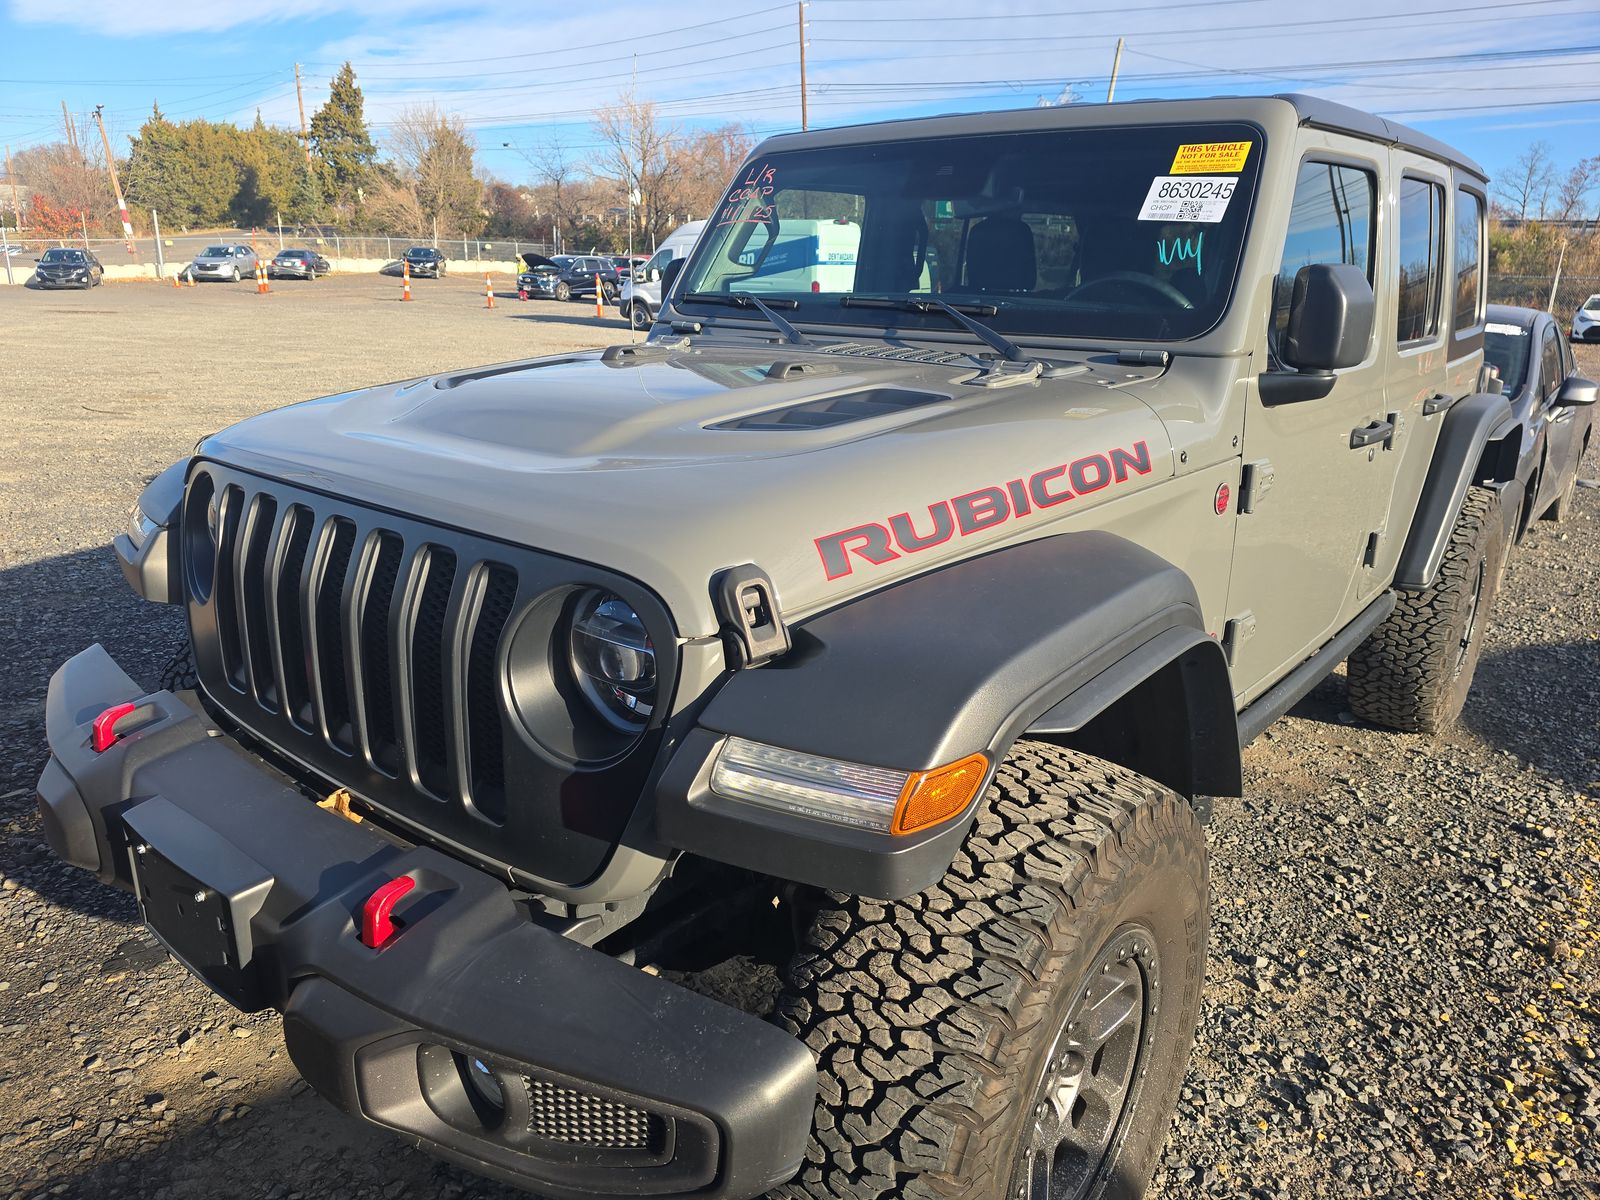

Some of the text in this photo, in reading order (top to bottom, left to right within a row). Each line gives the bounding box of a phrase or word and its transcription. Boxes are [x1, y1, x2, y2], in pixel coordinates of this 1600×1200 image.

[1205, 143, 1246, 152] VEHICLE
[1158, 181, 1236, 199] 8630245
[813, 440, 1152, 581] RUBICON
